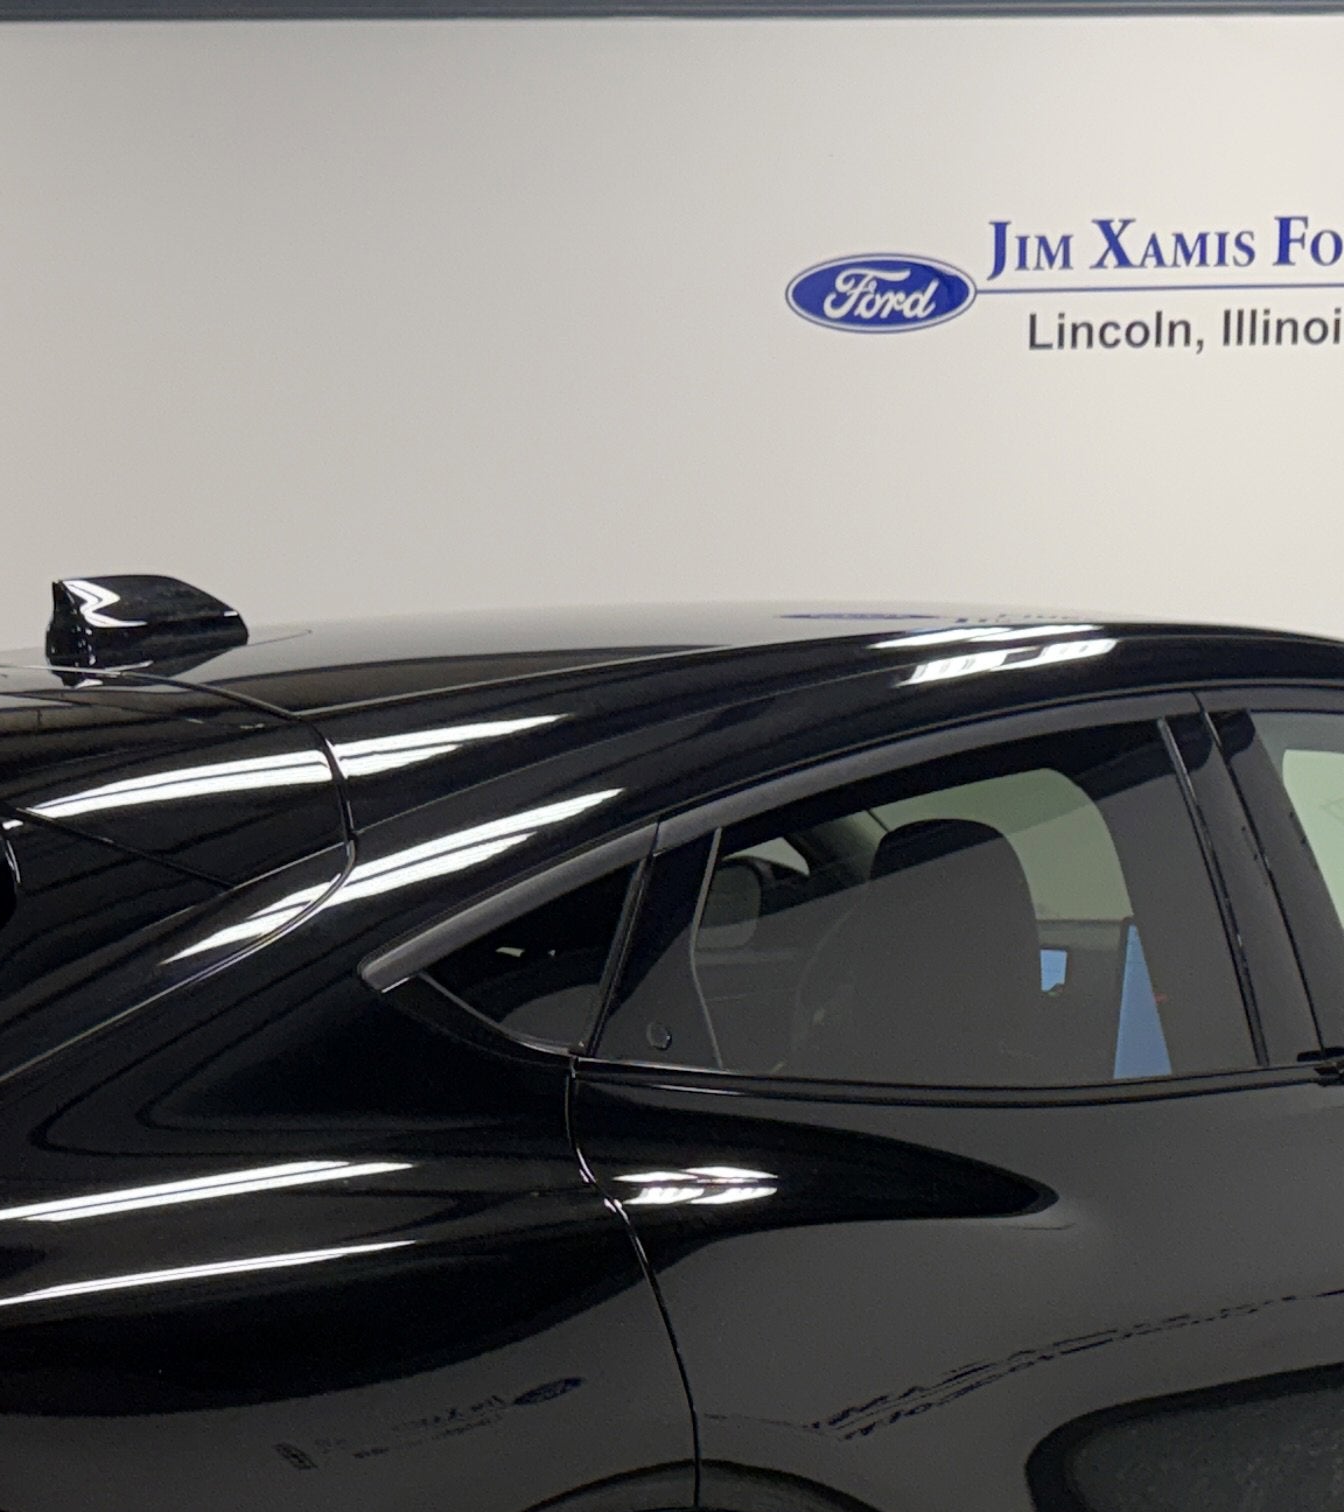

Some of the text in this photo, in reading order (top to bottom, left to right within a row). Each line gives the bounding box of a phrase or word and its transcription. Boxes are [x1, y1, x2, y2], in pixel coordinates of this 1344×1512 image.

[987, 220, 1073, 281] JIM
[1089, 218, 1256, 271] XAMIS
[823, 265, 937, 320] Ford
[1028, 310, 1205, 355] Lincoln,
